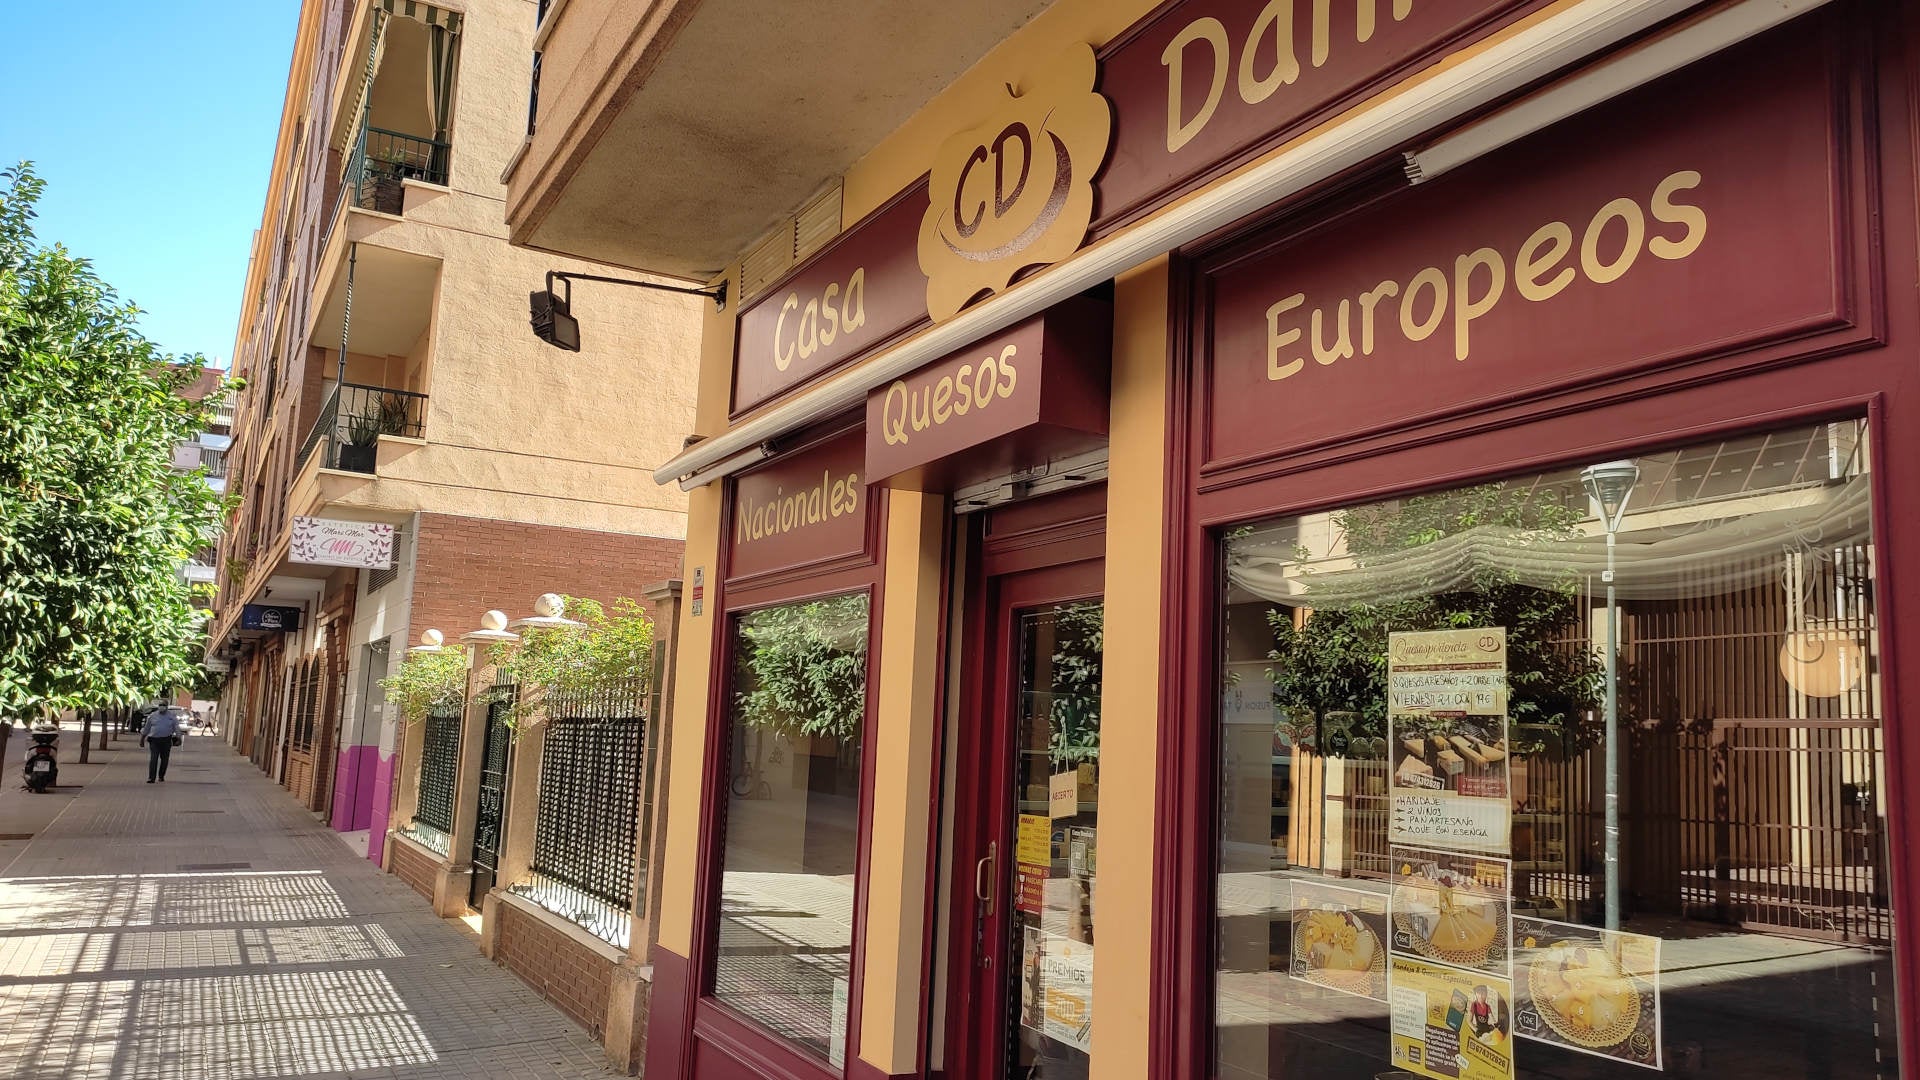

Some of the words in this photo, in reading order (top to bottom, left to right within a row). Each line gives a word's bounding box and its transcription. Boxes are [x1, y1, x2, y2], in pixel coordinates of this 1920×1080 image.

[774, 267, 867, 373] Casa
[1161, 0, 1413, 153] Dan
[954, 121, 1032, 239] CD
[1265, 170, 1708, 382] Europeos
[882, 344, 1018, 446] Quesos
[736, 473, 860, 545] Nacionales
